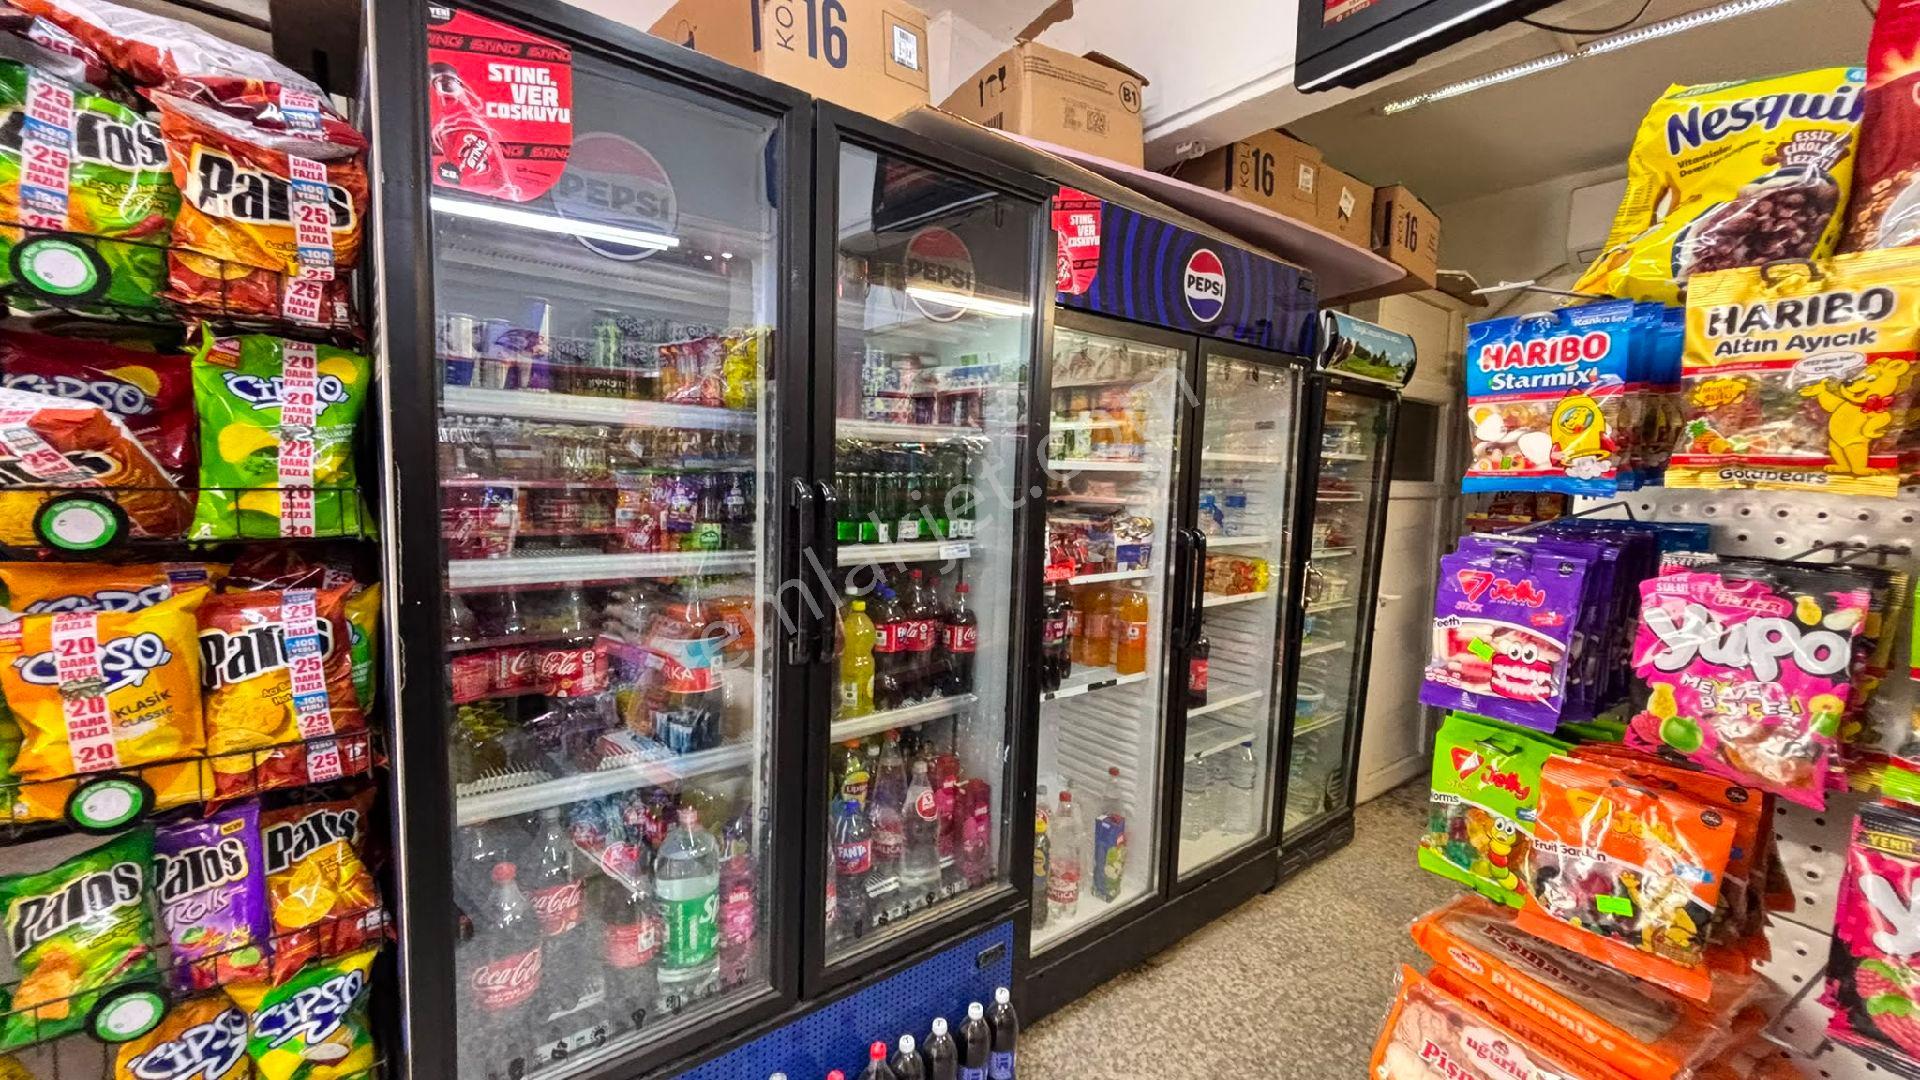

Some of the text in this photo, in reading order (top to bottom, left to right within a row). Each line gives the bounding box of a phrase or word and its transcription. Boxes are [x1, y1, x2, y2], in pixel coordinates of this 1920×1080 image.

[803, 0, 848, 69] 16
[488, 63, 557, 88] STING.
[486, 101, 570, 123] COŞKUYU
[510, 83, 559, 108] VER
[1123, 86, 1138, 106] B1
[1252, 148, 1275, 197] 16
[559, 173, 670, 218] PEPSI
[1404, 211, 1418, 253] 16
[908, 257, 974, 290] PEPSI
[1187, 273, 1224, 298] PEPSI
[1708, 288, 1895, 337] HARIBO
[1481, 333, 1609, 371] HARIBO
[1714, 327, 1878, 358] Altın Ayıcık
[1643, 602, 1850, 683] Yupo
[59, 656, 97, 669] DAHA
